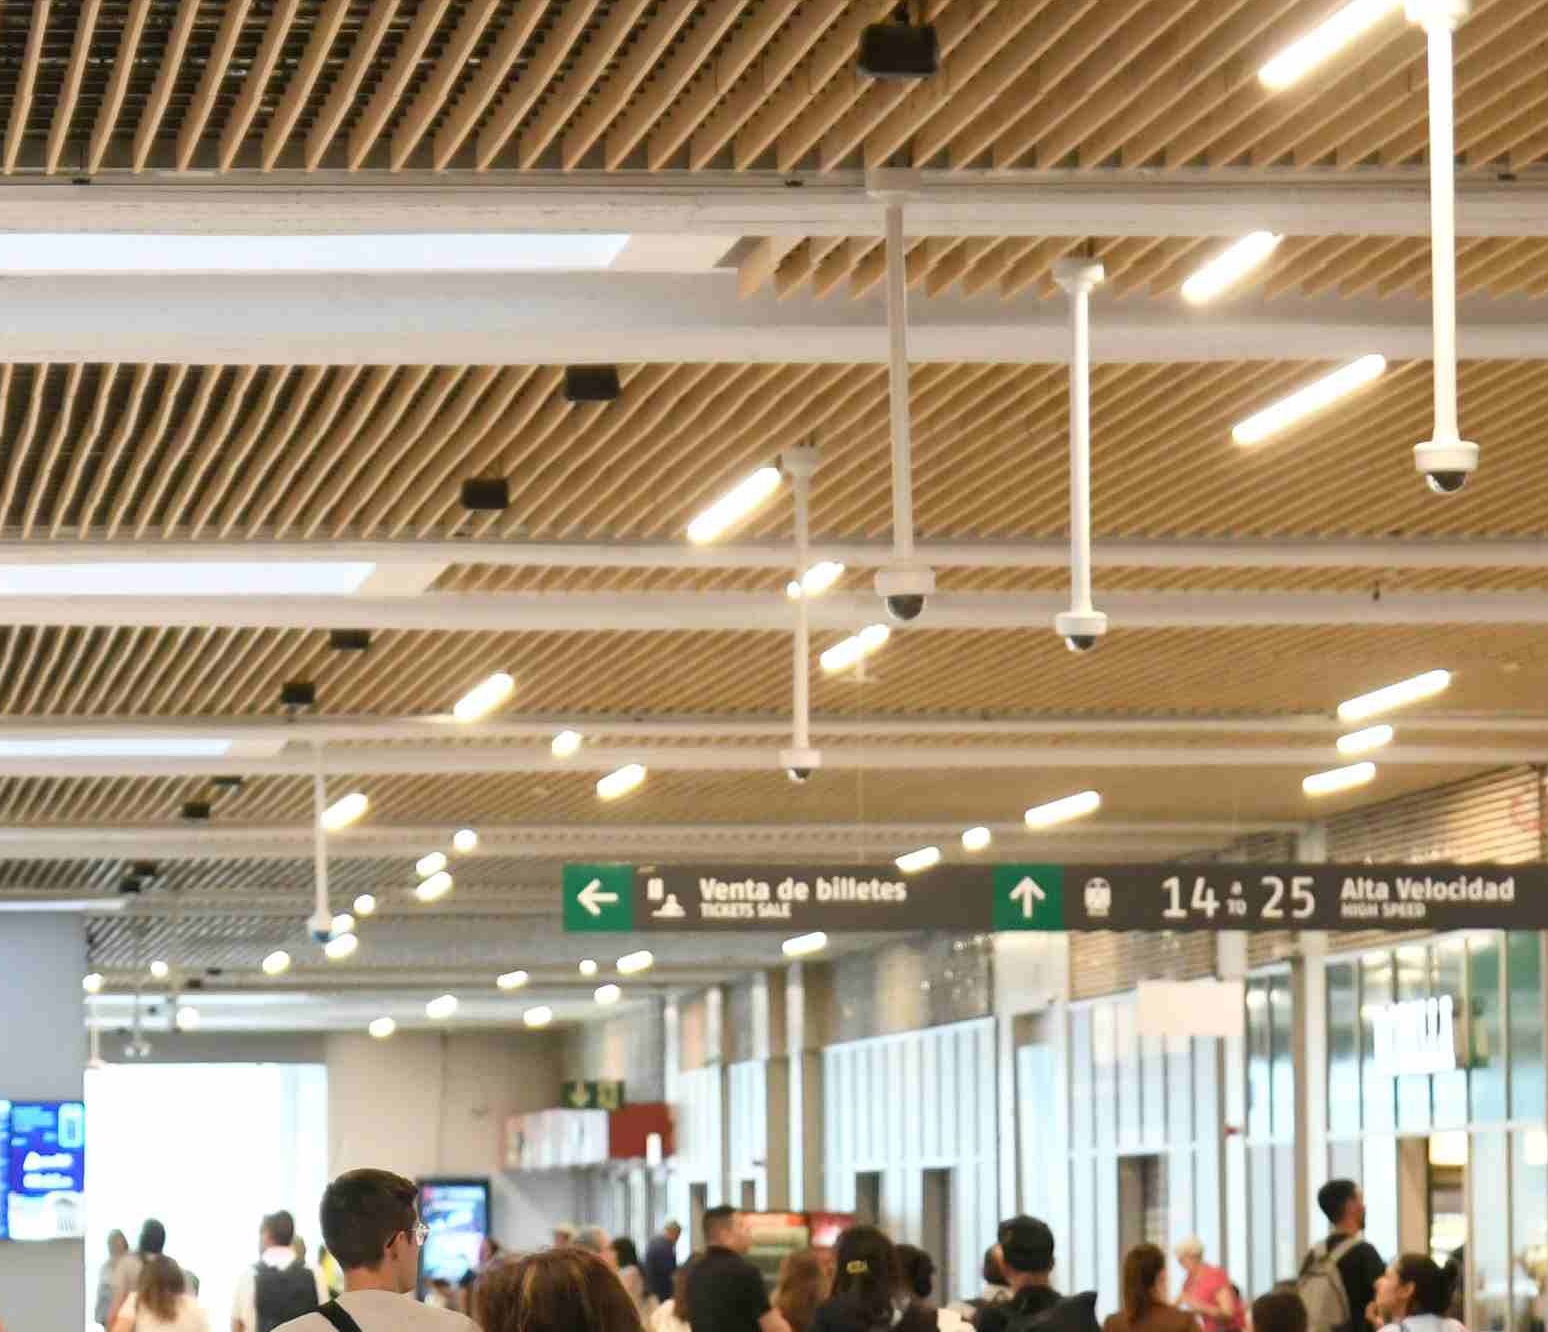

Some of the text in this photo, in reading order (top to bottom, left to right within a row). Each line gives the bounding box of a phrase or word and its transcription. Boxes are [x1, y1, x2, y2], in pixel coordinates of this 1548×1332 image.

[699, 876, 908, 901] Venta de billetes
[1161, 876, 1220, 919] 14
[1260, 876, 1316, 919] 25
[1340, 876, 1515, 901] Alta Velocidad
[700, 902, 792, 918] TICKETS SALE
[1340, 902, 1426, 918] HIGH SPEED
